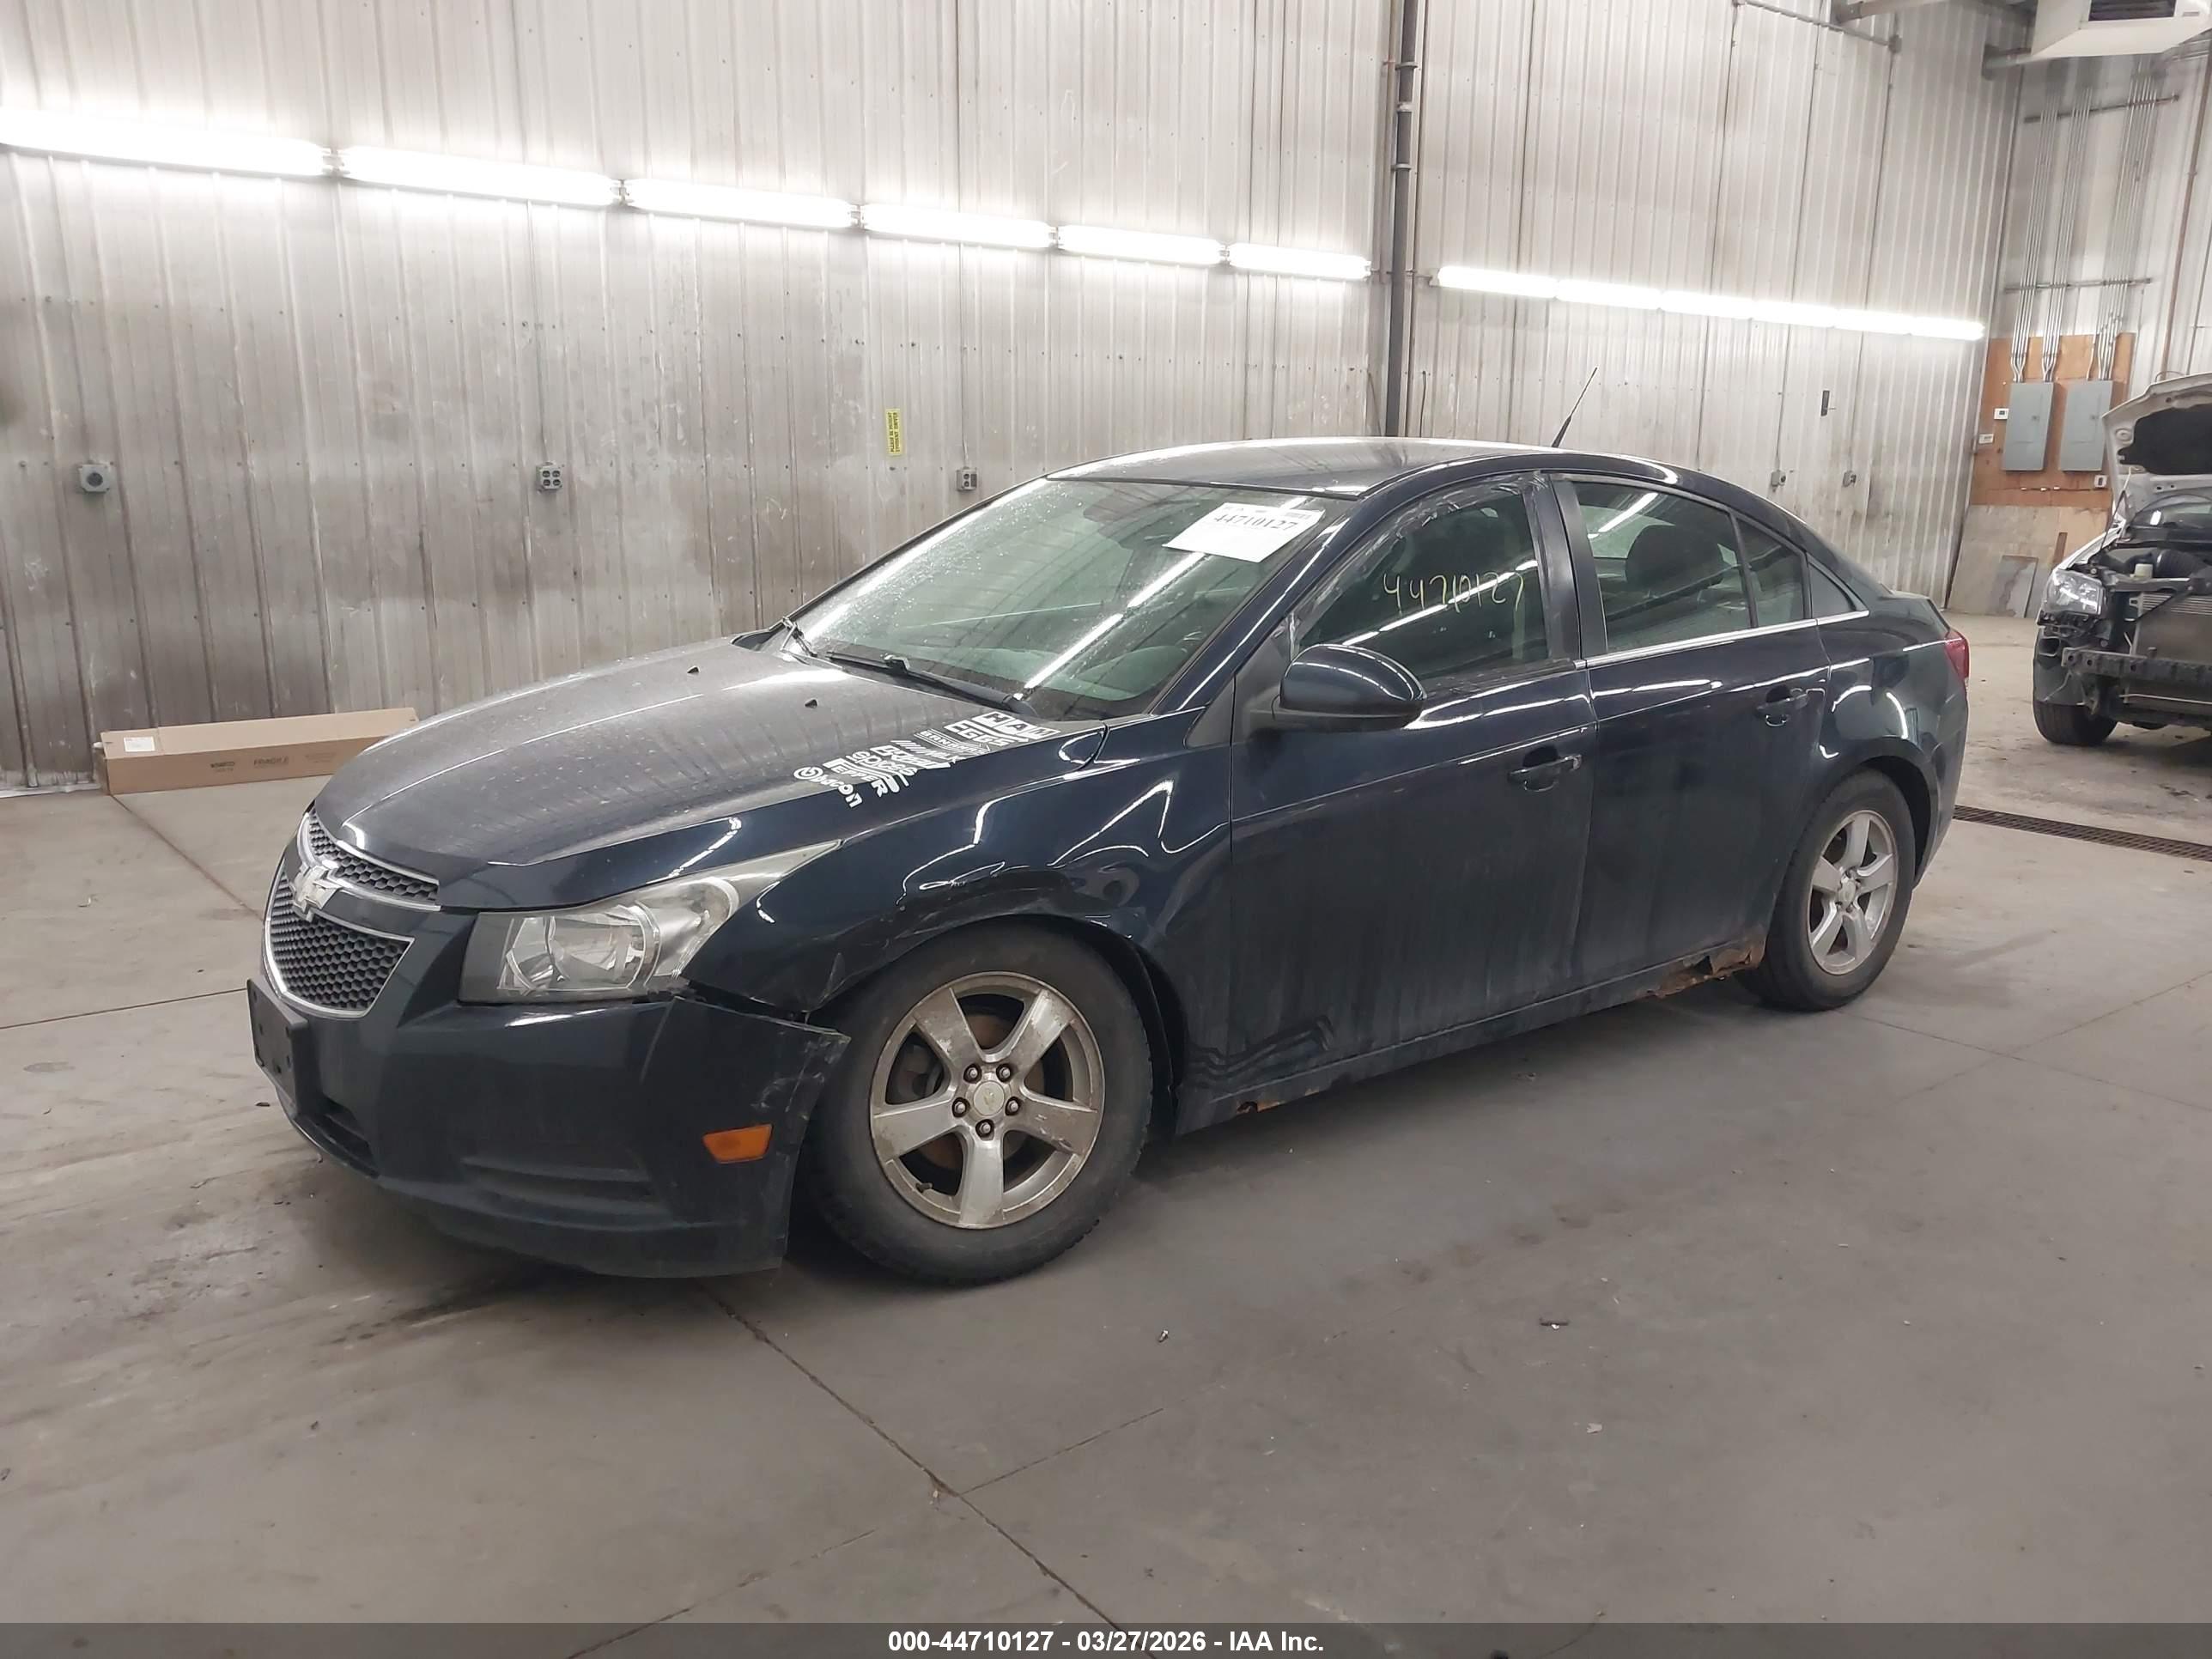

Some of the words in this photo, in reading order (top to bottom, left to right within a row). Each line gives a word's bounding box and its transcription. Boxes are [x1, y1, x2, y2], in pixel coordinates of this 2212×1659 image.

[1213, 514, 1299, 531] 44710127
[1382, 570, 1525, 614] 44710127
[944, 720, 1025, 746] EGGS
[975, 712, 1059, 737] HAM
[810, 775, 863, 808] bacon
